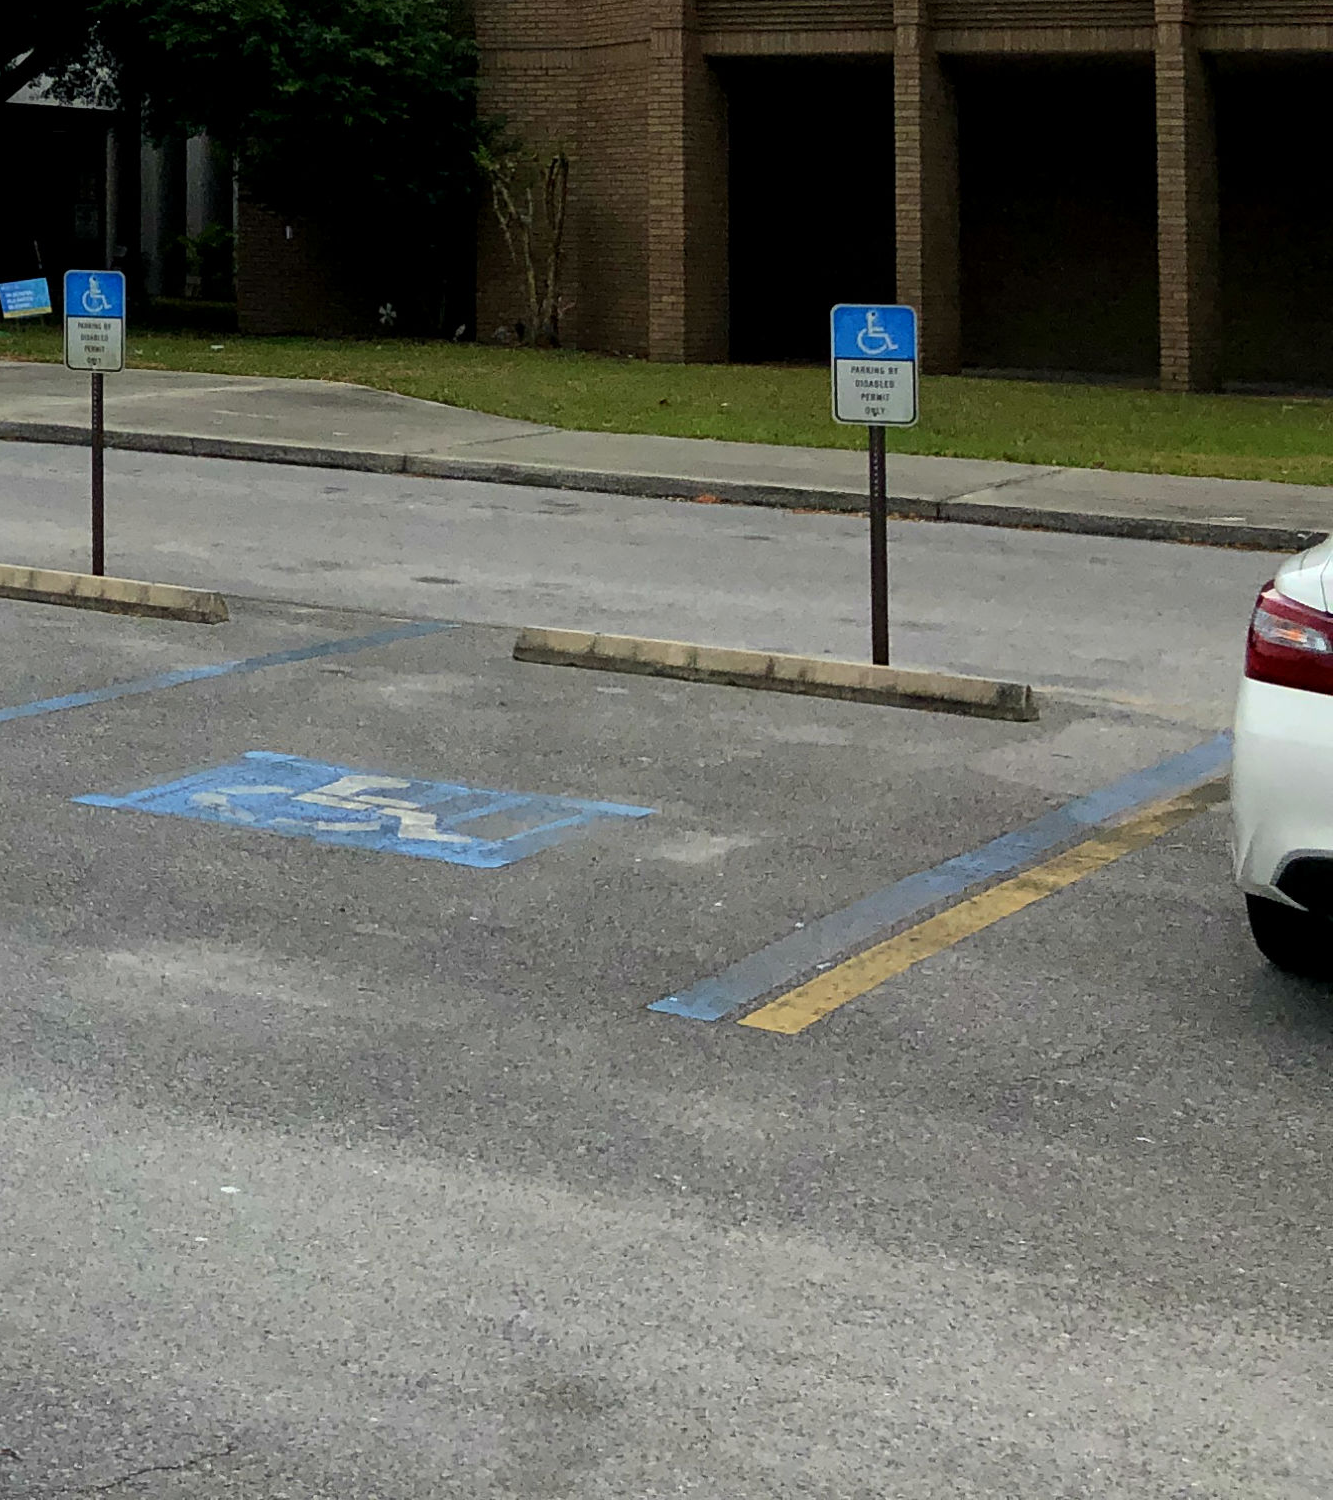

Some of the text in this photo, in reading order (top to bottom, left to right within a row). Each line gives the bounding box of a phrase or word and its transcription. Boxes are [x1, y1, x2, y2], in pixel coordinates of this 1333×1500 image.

[77, 322, 101, 330] PARKING
[84, 345, 105, 353] PERMIT
[850, 366, 899, 375] PARKING BY
[855, 380, 895, 389] DISABLED
[860, 393, 890, 402] PERMIT
[864, 406, 886, 417] ONLY
